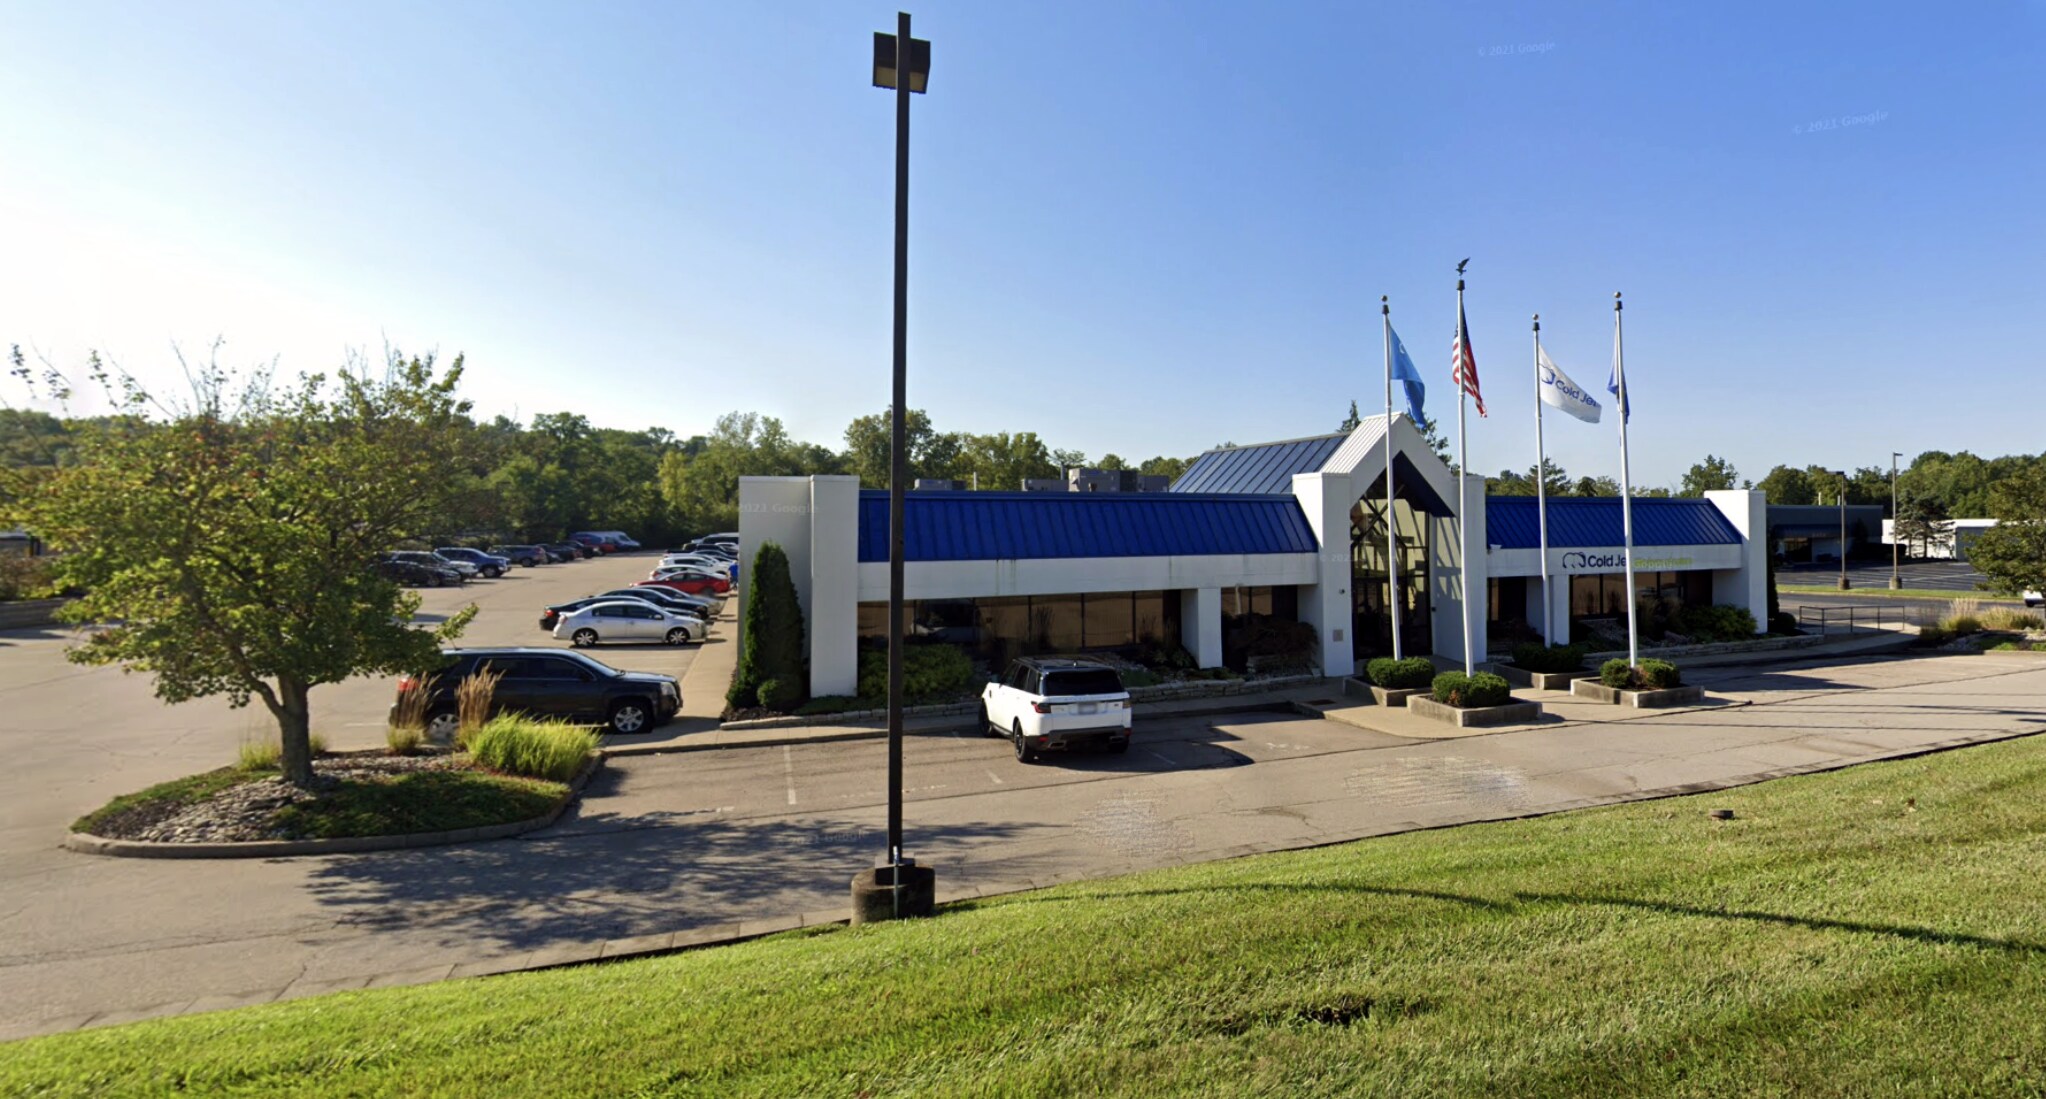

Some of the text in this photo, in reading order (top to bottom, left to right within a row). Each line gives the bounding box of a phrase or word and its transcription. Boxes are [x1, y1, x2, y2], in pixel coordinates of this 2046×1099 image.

[1555, 379, 1580, 400] Cold
[1588, 554, 1614, 568] Cold
[1614, 554, 1627, 567] Je
